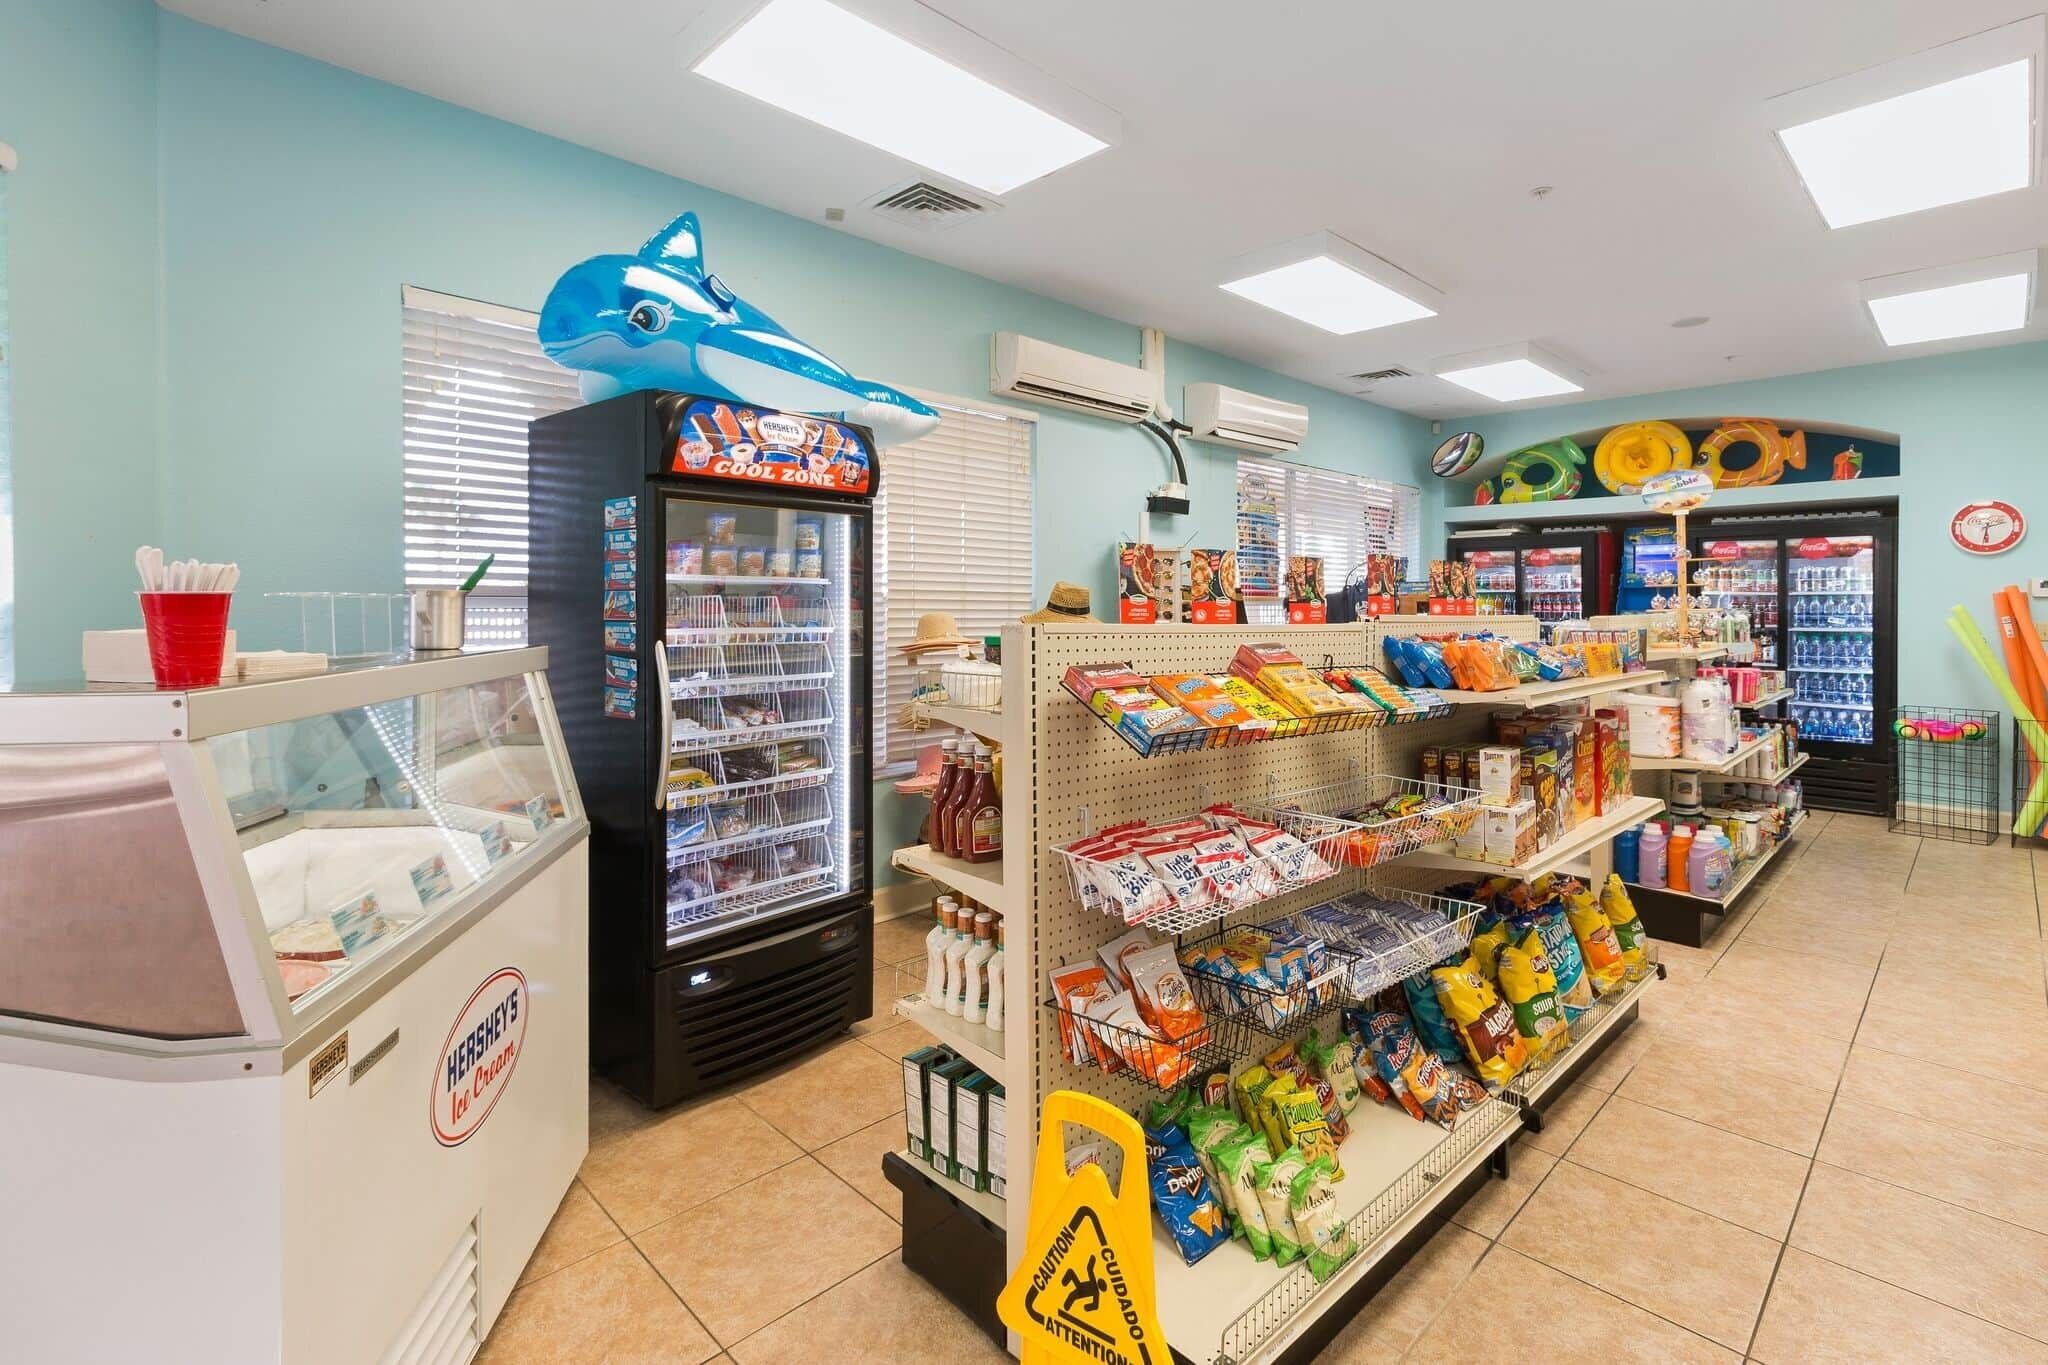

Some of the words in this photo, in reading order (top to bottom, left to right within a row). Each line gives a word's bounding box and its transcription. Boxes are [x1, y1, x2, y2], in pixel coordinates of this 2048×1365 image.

[763, 420, 800, 435] HERSHEY'S
[713, 461, 775, 481] COOL
[781, 469, 835, 487] ZONE
[1532, 998, 1554, 1016] SOUR
[447, 987, 519, 1093] HERSHEY'S
[451, 1088, 471, 1126] Ice
[473, 1039, 515, 1099] Cream
[1167, 1166, 1204, 1194] Doritos
[1033, 1226, 1076, 1292] CAUTION
[1101, 1247, 1144, 1340] CUIDADO
[1045, 1316, 1132, 1365] ATTENTION
